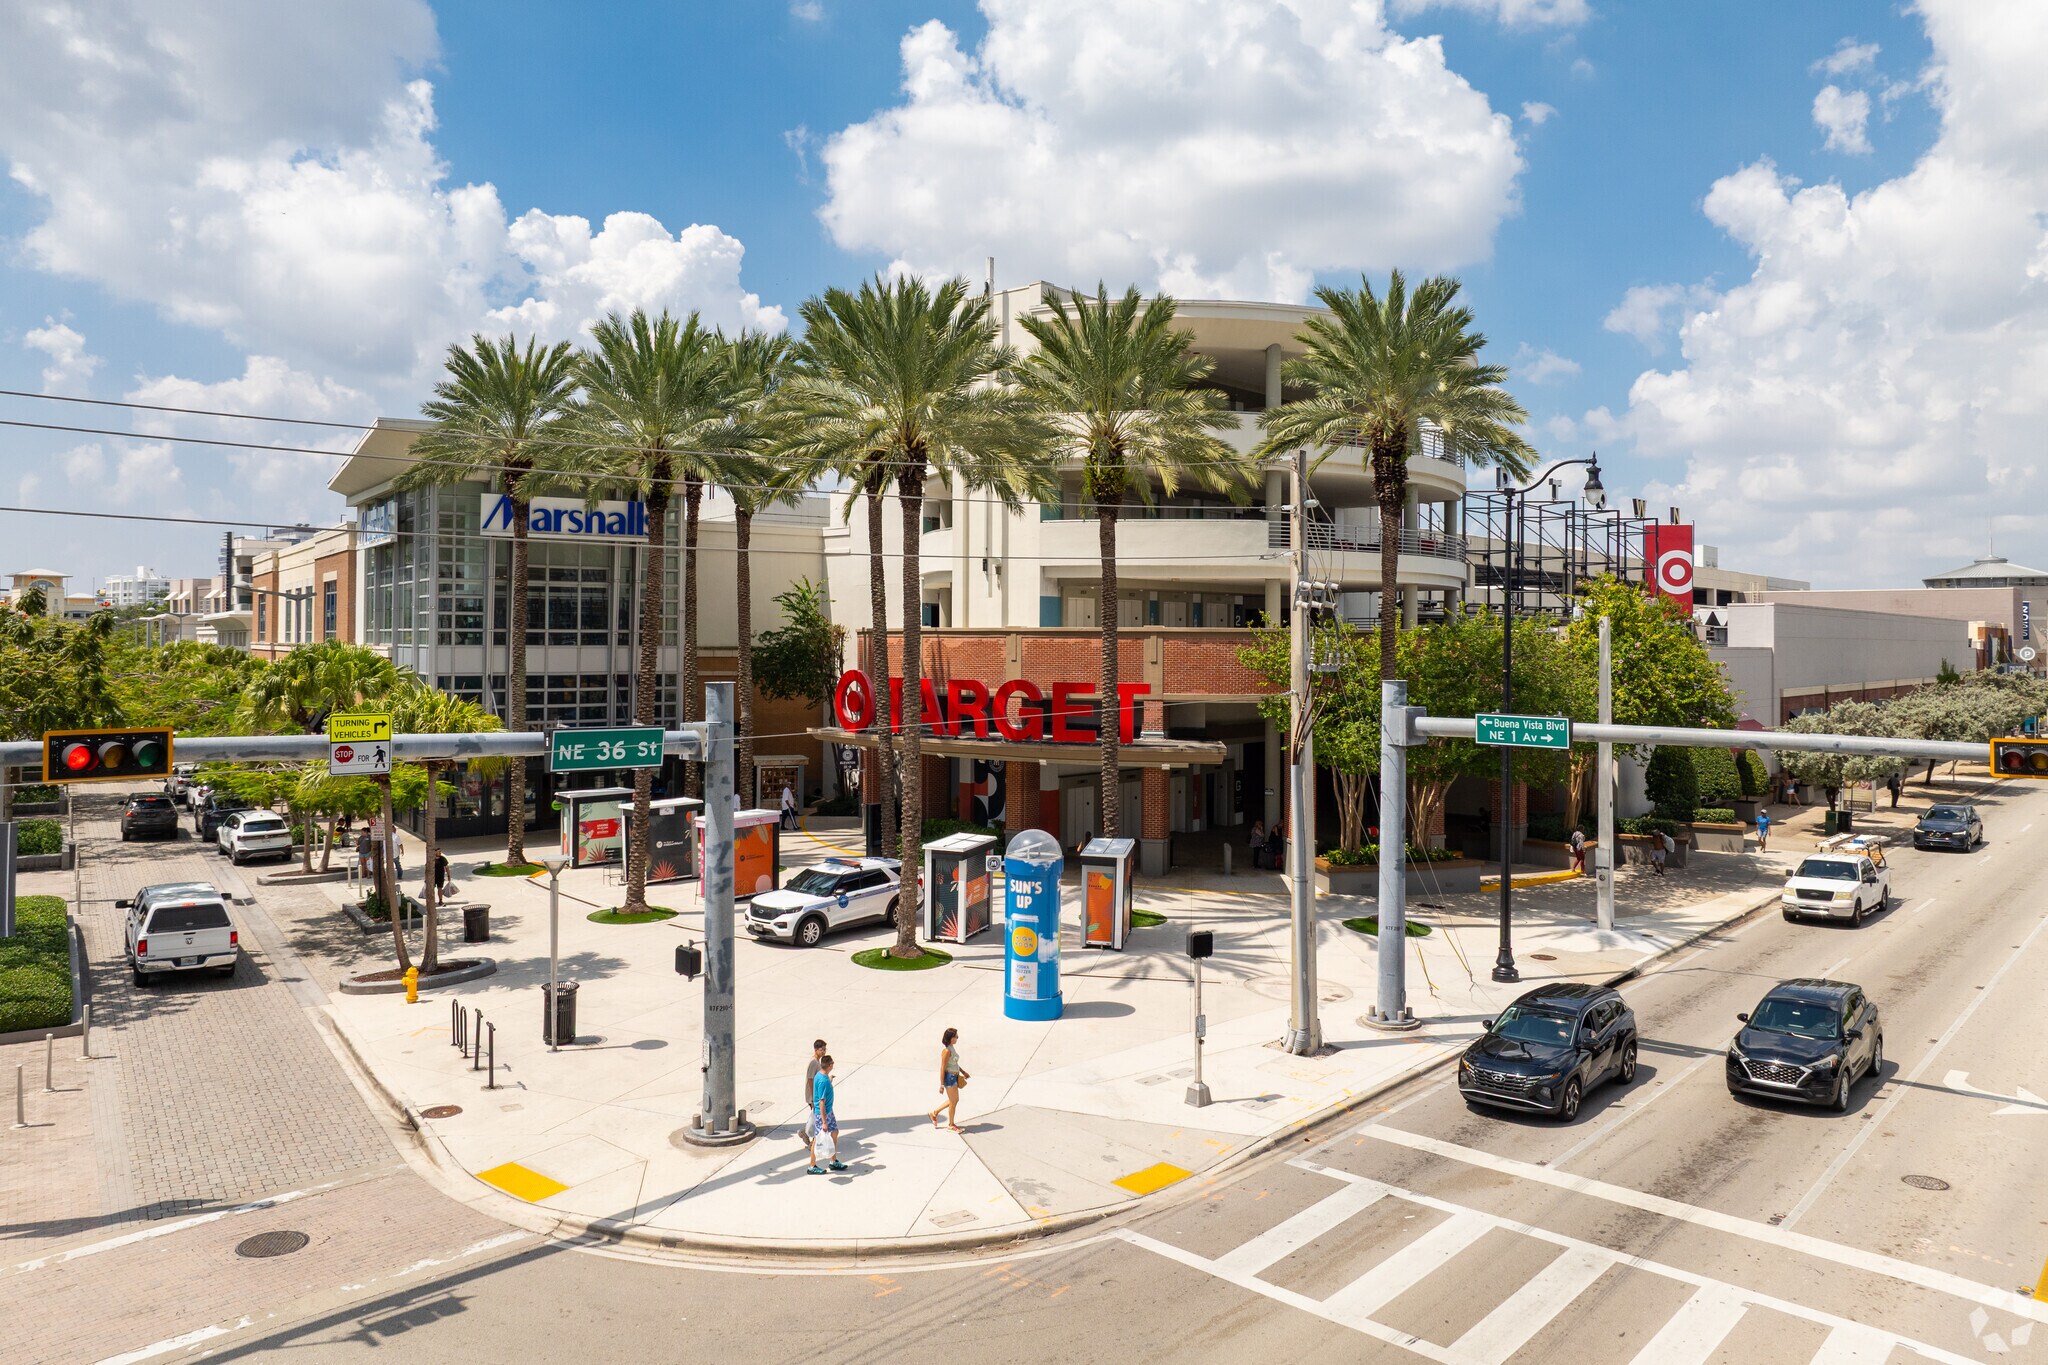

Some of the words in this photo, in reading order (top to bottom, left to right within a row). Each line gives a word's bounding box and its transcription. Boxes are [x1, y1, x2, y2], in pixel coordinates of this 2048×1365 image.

[482, 494, 650, 536] Marshall
[1235, 615, 1241, 626] 2
[335, 719, 370, 727] TURNING
[1494, 718, 1519, 729] Buena
[1523, 720, 1543, 730] Vista
[1546, 721, 1565, 731] Blvd
[334, 730, 371, 738] VEHICLES
[1489, 730, 1505, 740] NE
[1511, 730, 1516, 742] 1
[1522, 733, 1537, 742] Av
[335, 750, 353, 758] STOP
[559, 743, 585, 761] NE
[596, 740, 626, 761] 36
[637, 741, 657, 757] St
[1010, 879, 1043, 894] SUN'S
[1016, 895, 1032, 909] UP
